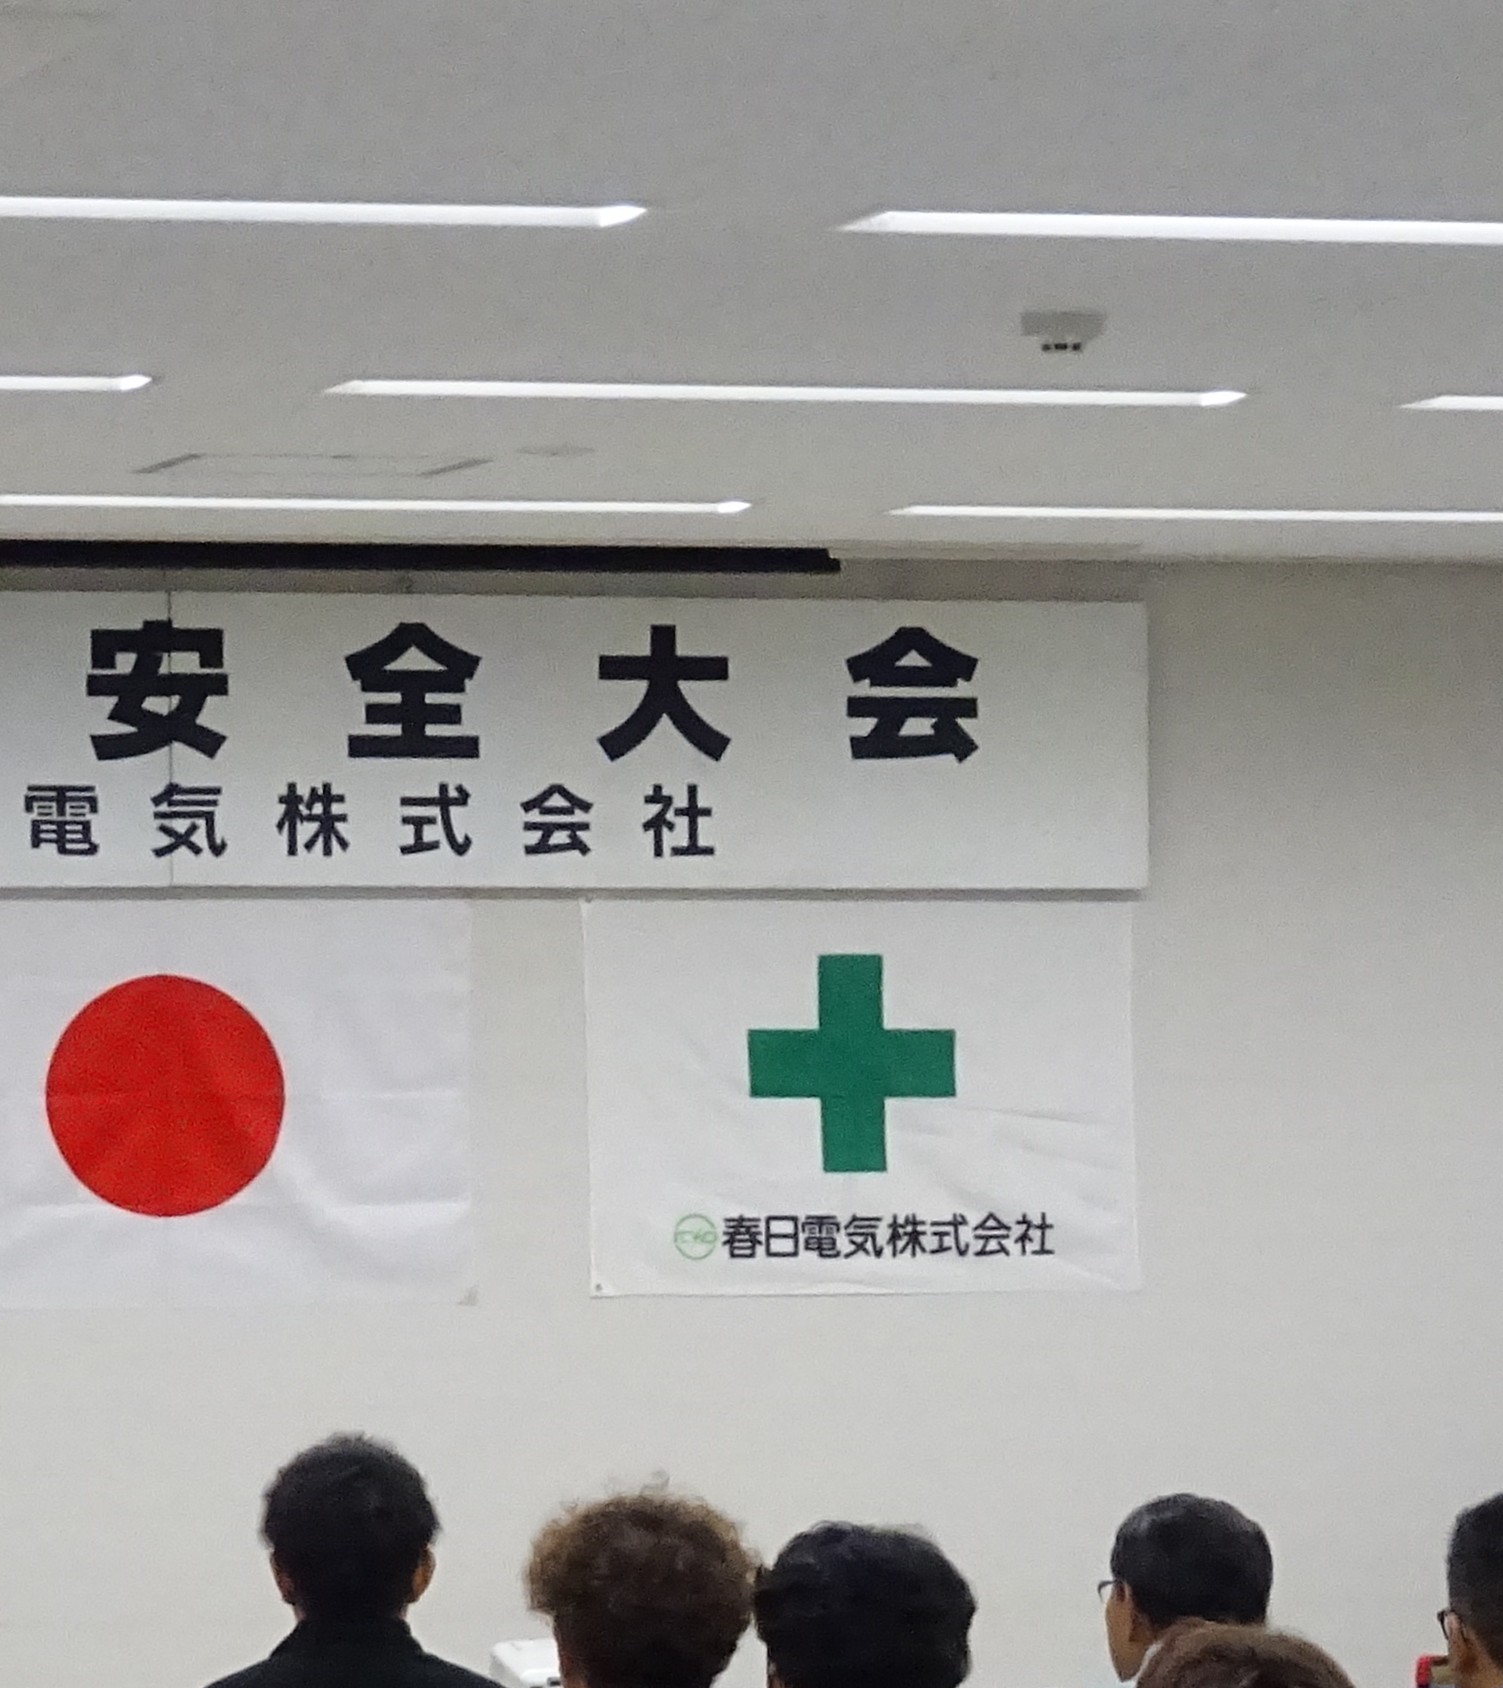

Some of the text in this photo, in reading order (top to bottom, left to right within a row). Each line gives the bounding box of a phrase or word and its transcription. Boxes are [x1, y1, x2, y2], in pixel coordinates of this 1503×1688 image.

[721, 1211, 1056, 1260] 春日電気株式会社
